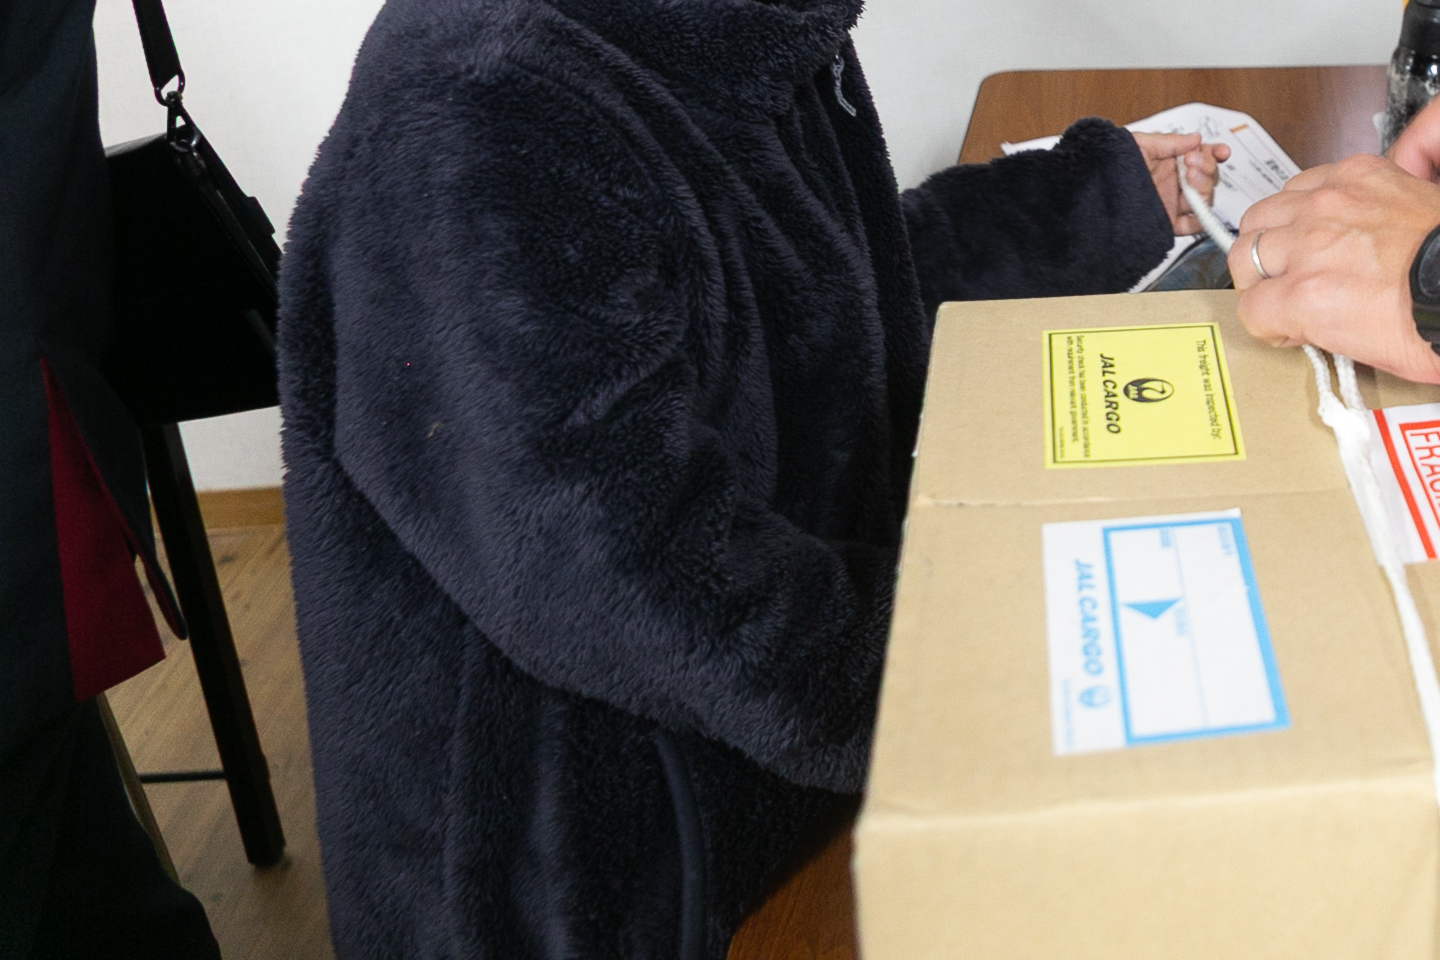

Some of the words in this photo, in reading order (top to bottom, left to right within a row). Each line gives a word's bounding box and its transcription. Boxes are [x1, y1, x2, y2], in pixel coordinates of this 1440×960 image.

[1076, 335, 1085, 354] Security
[1196, 339, 1207, 352] This
[1077, 355, 1085, 369] check
[1100, 353, 1116, 377] JAL
[1199, 354, 1211, 376] freight
[1203, 378, 1213, 391] was
[1102, 379, 1122, 434] CARGO
[1206, 393, 1220, 427] inspected
[1074, 558, 1095, 593] JAL
[1079, 596, 1103, 676] CARGO
